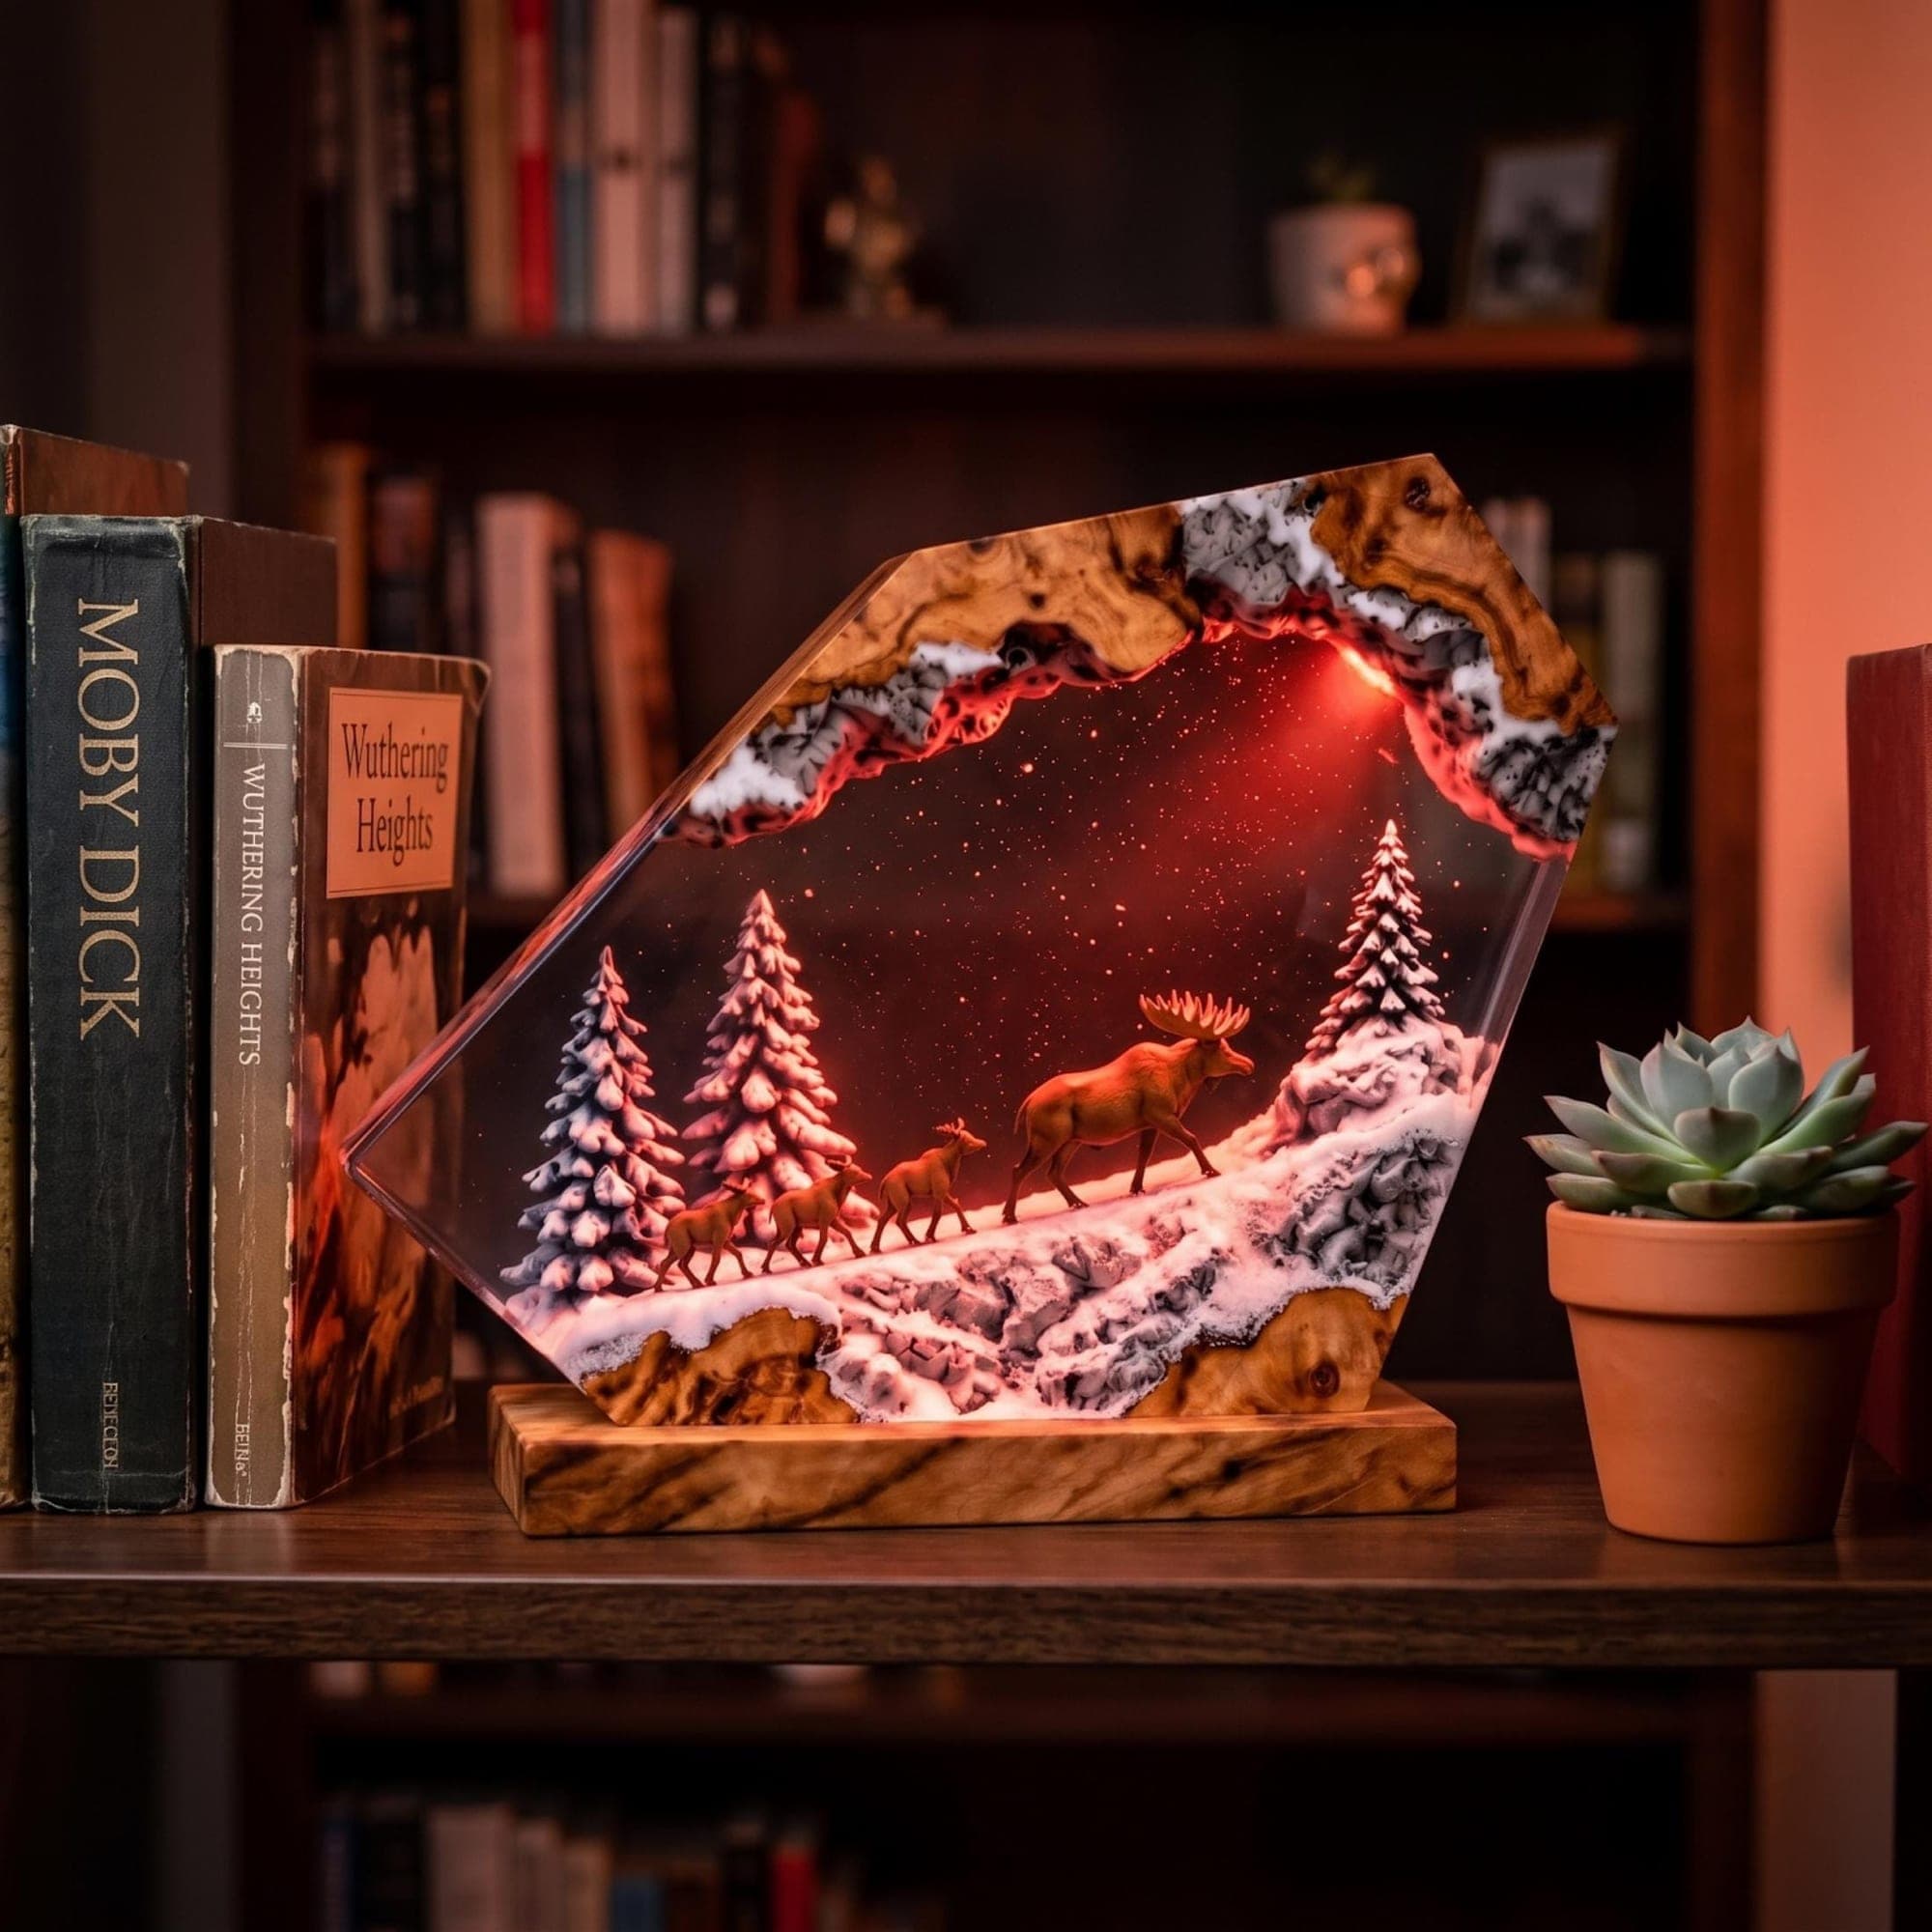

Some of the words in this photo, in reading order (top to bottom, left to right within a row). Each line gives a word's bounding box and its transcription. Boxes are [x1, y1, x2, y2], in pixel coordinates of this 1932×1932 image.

[78, 598, 140, 827] MOBY
[343, 723, 448, 792] Wuthering
[241, 764, 266, 933] WUTHERING
[356, 797, 434, 867] Heights
[79, 846, 140, 1040] DICK
[239, 944, 265, 1065] HEIGHTS
